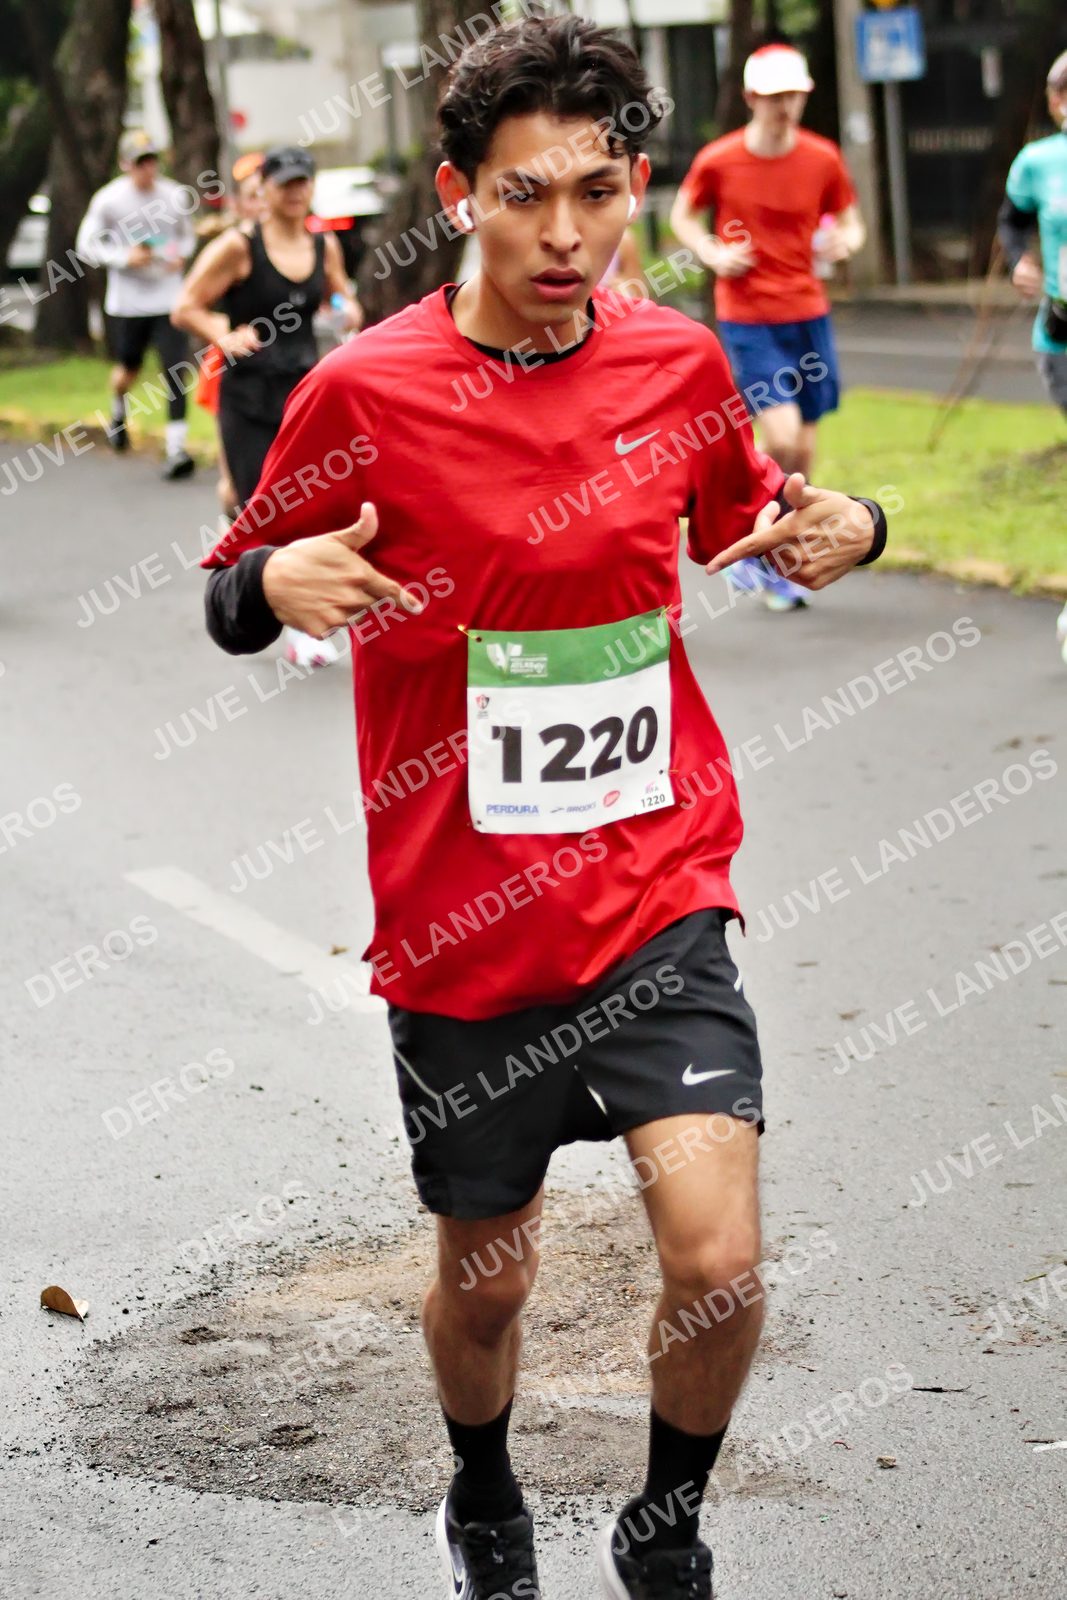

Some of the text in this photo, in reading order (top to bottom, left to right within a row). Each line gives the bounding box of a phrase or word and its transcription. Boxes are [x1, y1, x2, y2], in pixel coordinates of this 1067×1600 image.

[491, 705, 658, 784] 1220
[641, 793, 666, 808] 1220
[486, 804, 539, 816] PERDURA
